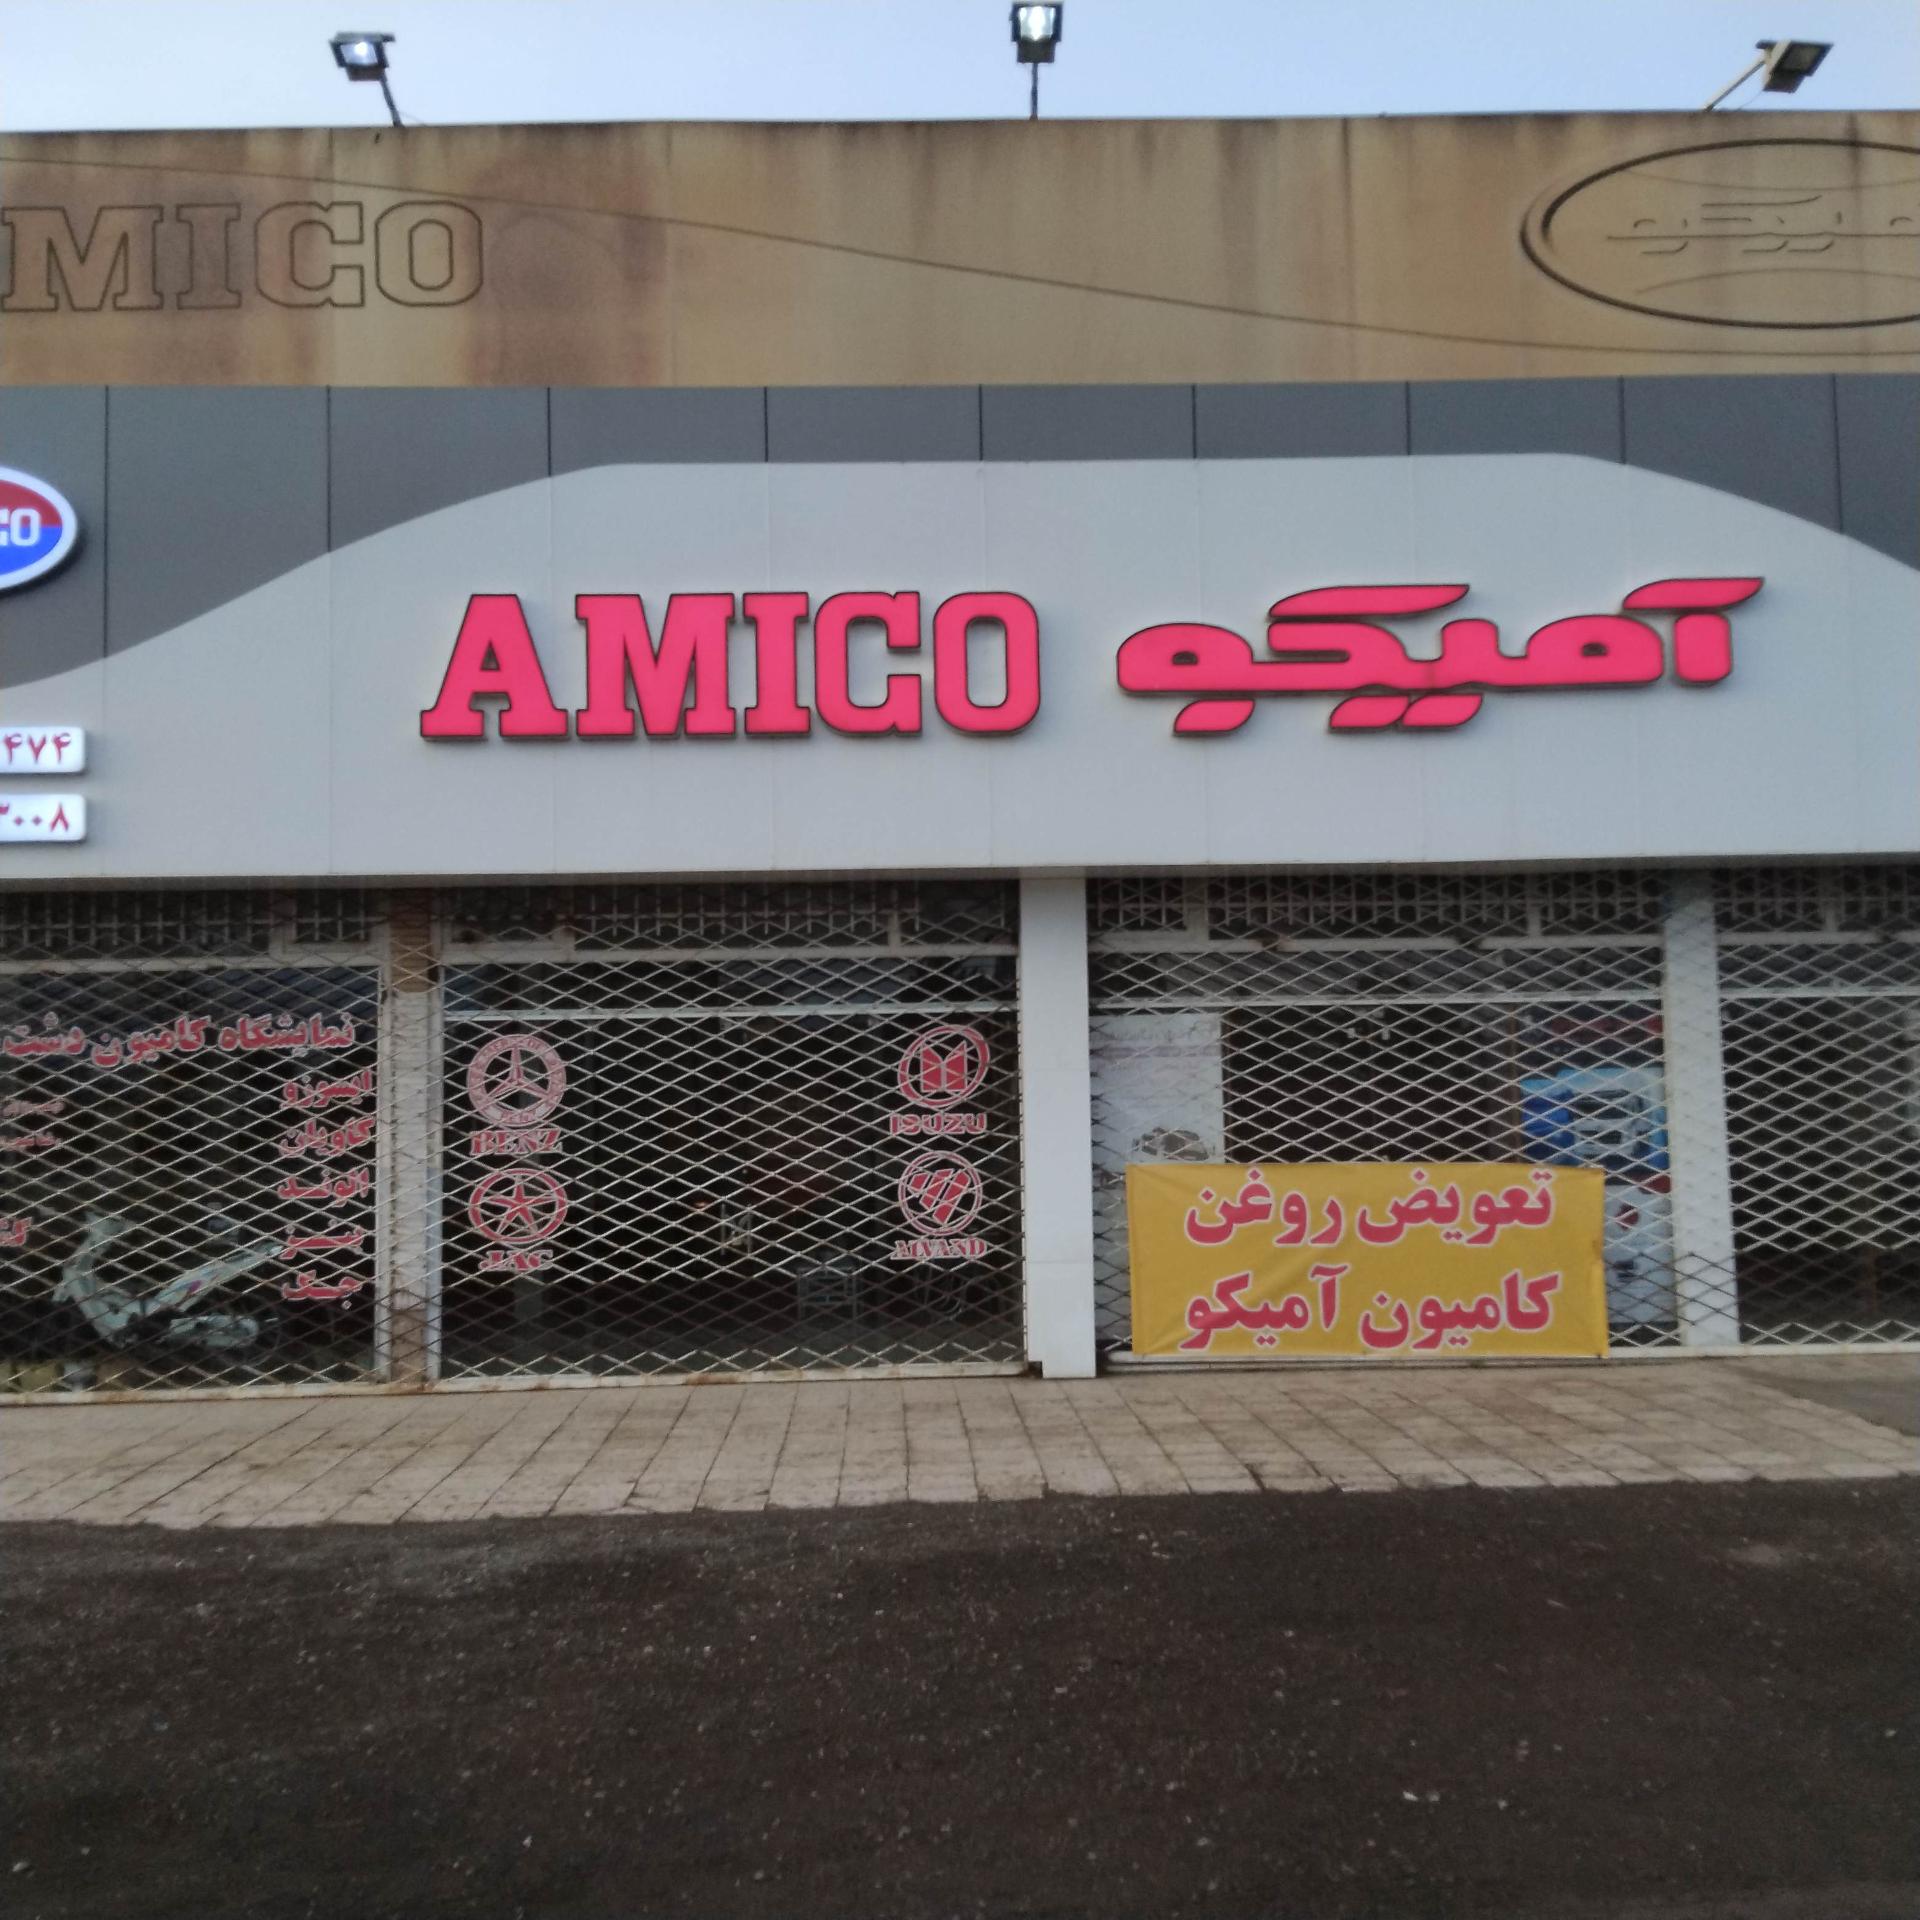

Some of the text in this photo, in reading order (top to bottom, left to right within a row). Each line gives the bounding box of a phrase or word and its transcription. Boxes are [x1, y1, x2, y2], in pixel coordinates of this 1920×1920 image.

[420, 590, 1042, 739] AMICO
[1115, 576, 1766, 735] آمیکو
[3, 732, 72, 765] ۴۷۴
[91, 1013, 211, 1068] کامیون
[218, 1012, 356, 1058] نمایشگاه
[279, 1068, 372, 1109] ایسوزو
[278, 1116, 376, 1159] کاویان
[469, 1127, 564, 1156] BENZ
[889, 1112, 988, 1136] ISUZU
[277, 1166, 370, 1208] الوند
[1184, 1168, 1554, 1247] تعویض روغن
[478, 1249, 554, 1273] JAC
[1178, 1263, 1562, 1352] کامیون آمیکو
